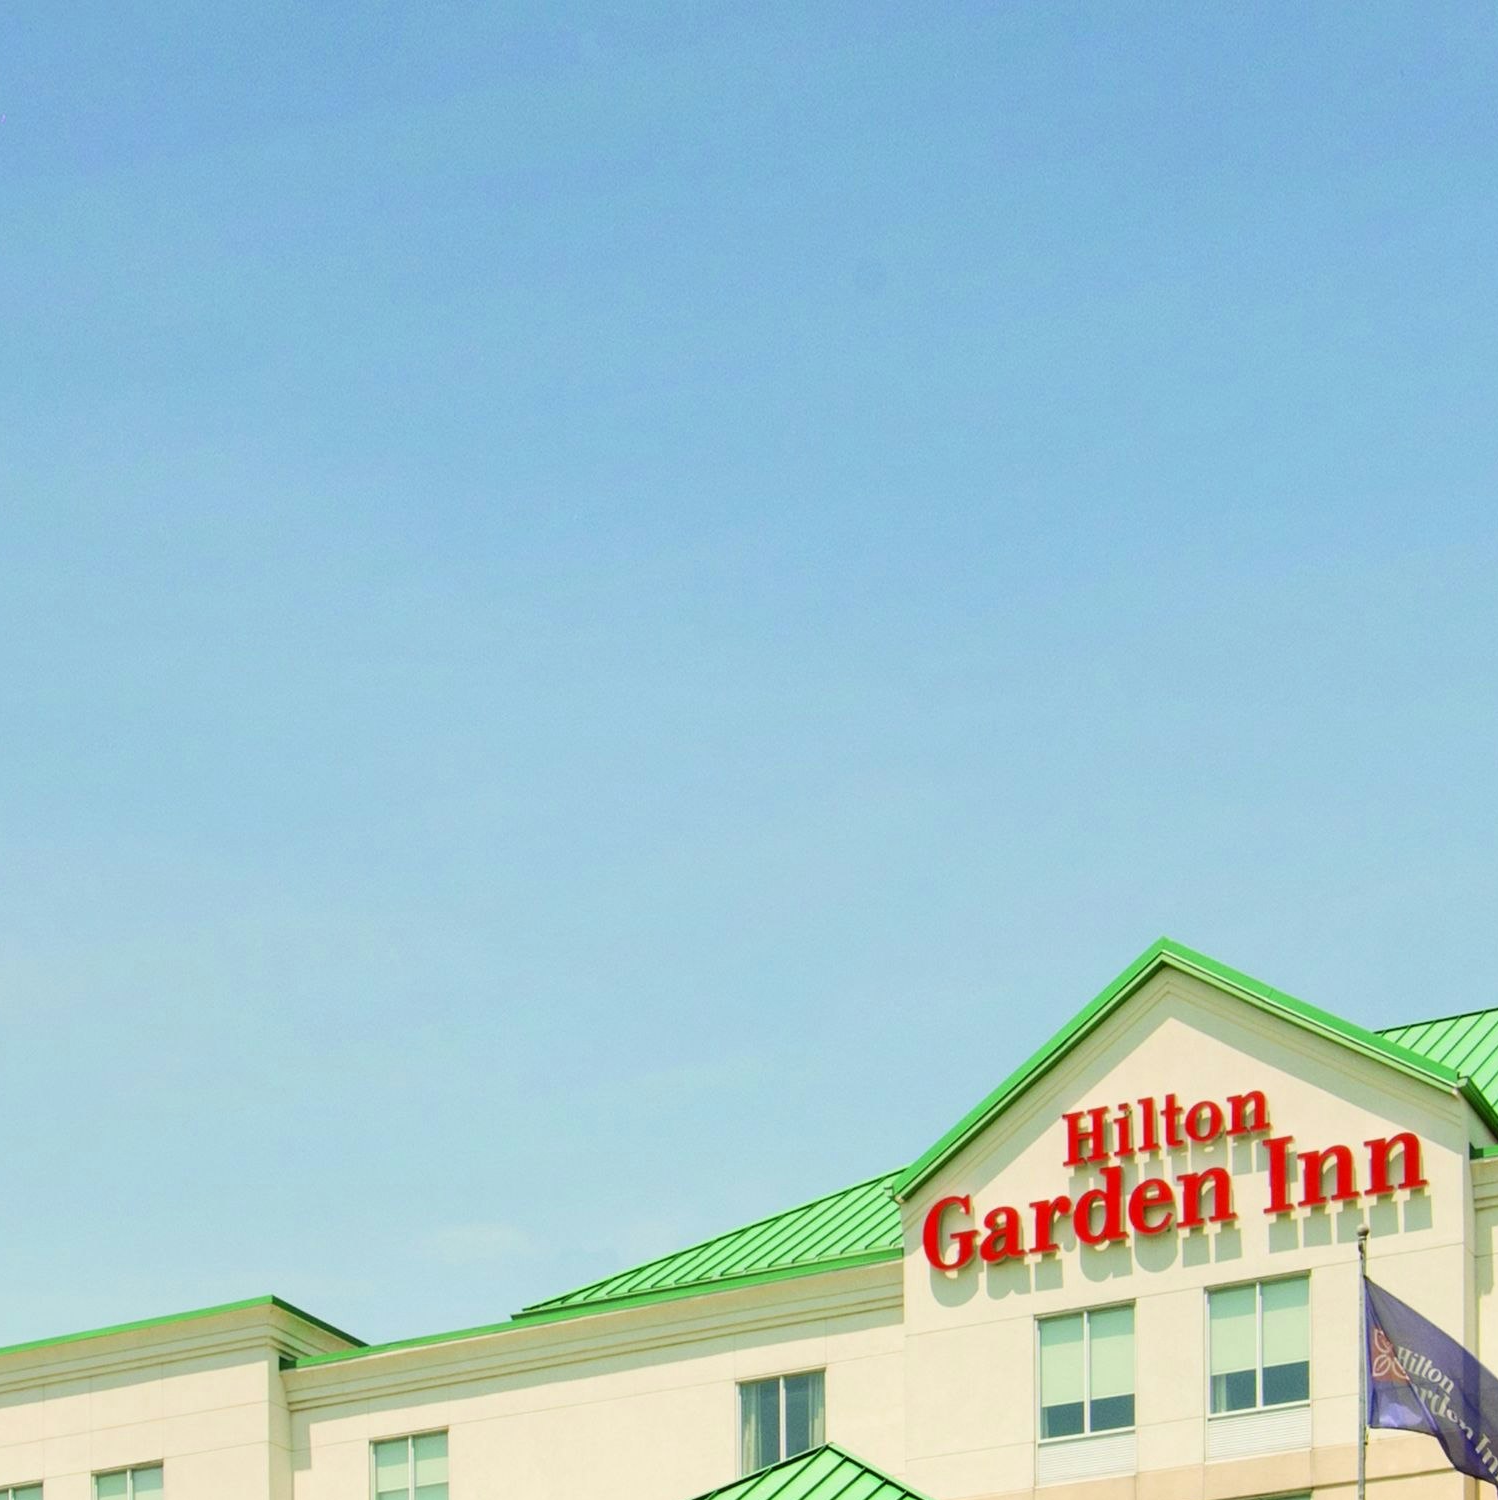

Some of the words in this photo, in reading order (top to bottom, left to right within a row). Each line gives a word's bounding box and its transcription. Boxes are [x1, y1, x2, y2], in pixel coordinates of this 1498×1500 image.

[1062, 1090, 1271, 1168] Hilton
[921, 1165, 1237, 1272] Garden
[1261, 1131, 1428, 1215] Inn
[1397, 1346, 1455, 1394] Hilton
